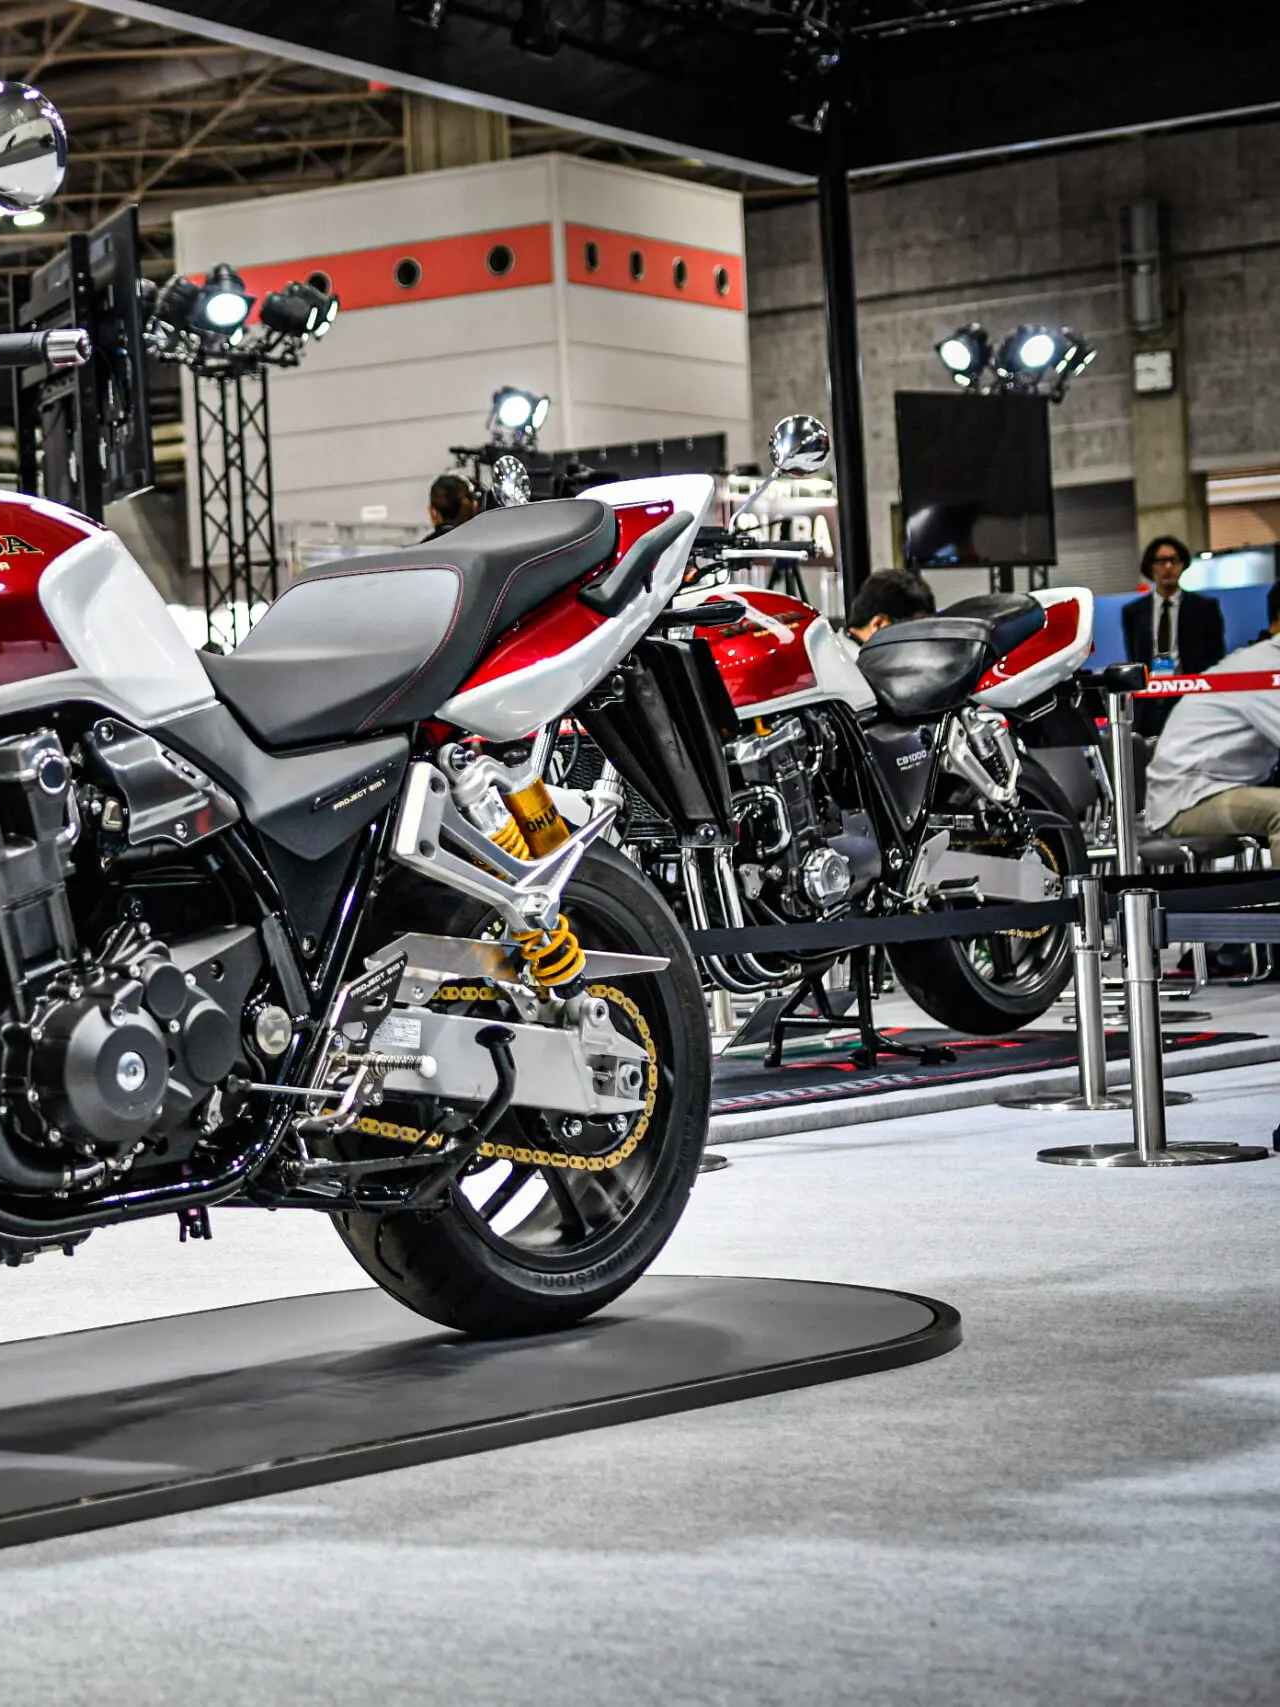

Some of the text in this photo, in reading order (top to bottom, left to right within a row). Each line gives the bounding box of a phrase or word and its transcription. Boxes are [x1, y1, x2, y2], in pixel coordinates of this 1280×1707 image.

[1139, 679, 1211, 694] ONDA
[332, 788, 368, 811] PROJECT
[350, 971, 386, 998] PROJECT
